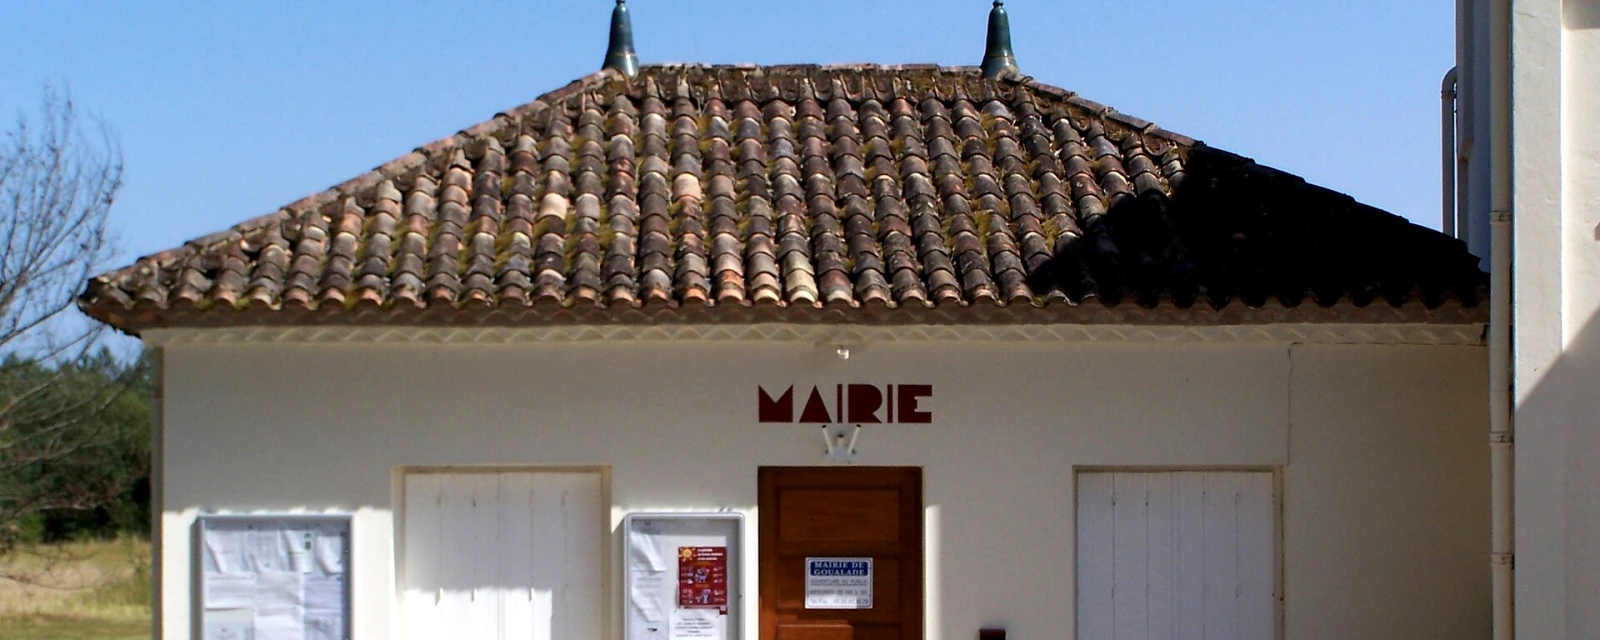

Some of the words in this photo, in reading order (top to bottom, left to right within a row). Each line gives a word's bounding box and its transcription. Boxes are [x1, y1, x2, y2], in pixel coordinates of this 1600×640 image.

[758, 384, 932, 424] MAIRIE
[814, 561, 849, 569] MAIRIE
[851, 561, 866, 569] DE
